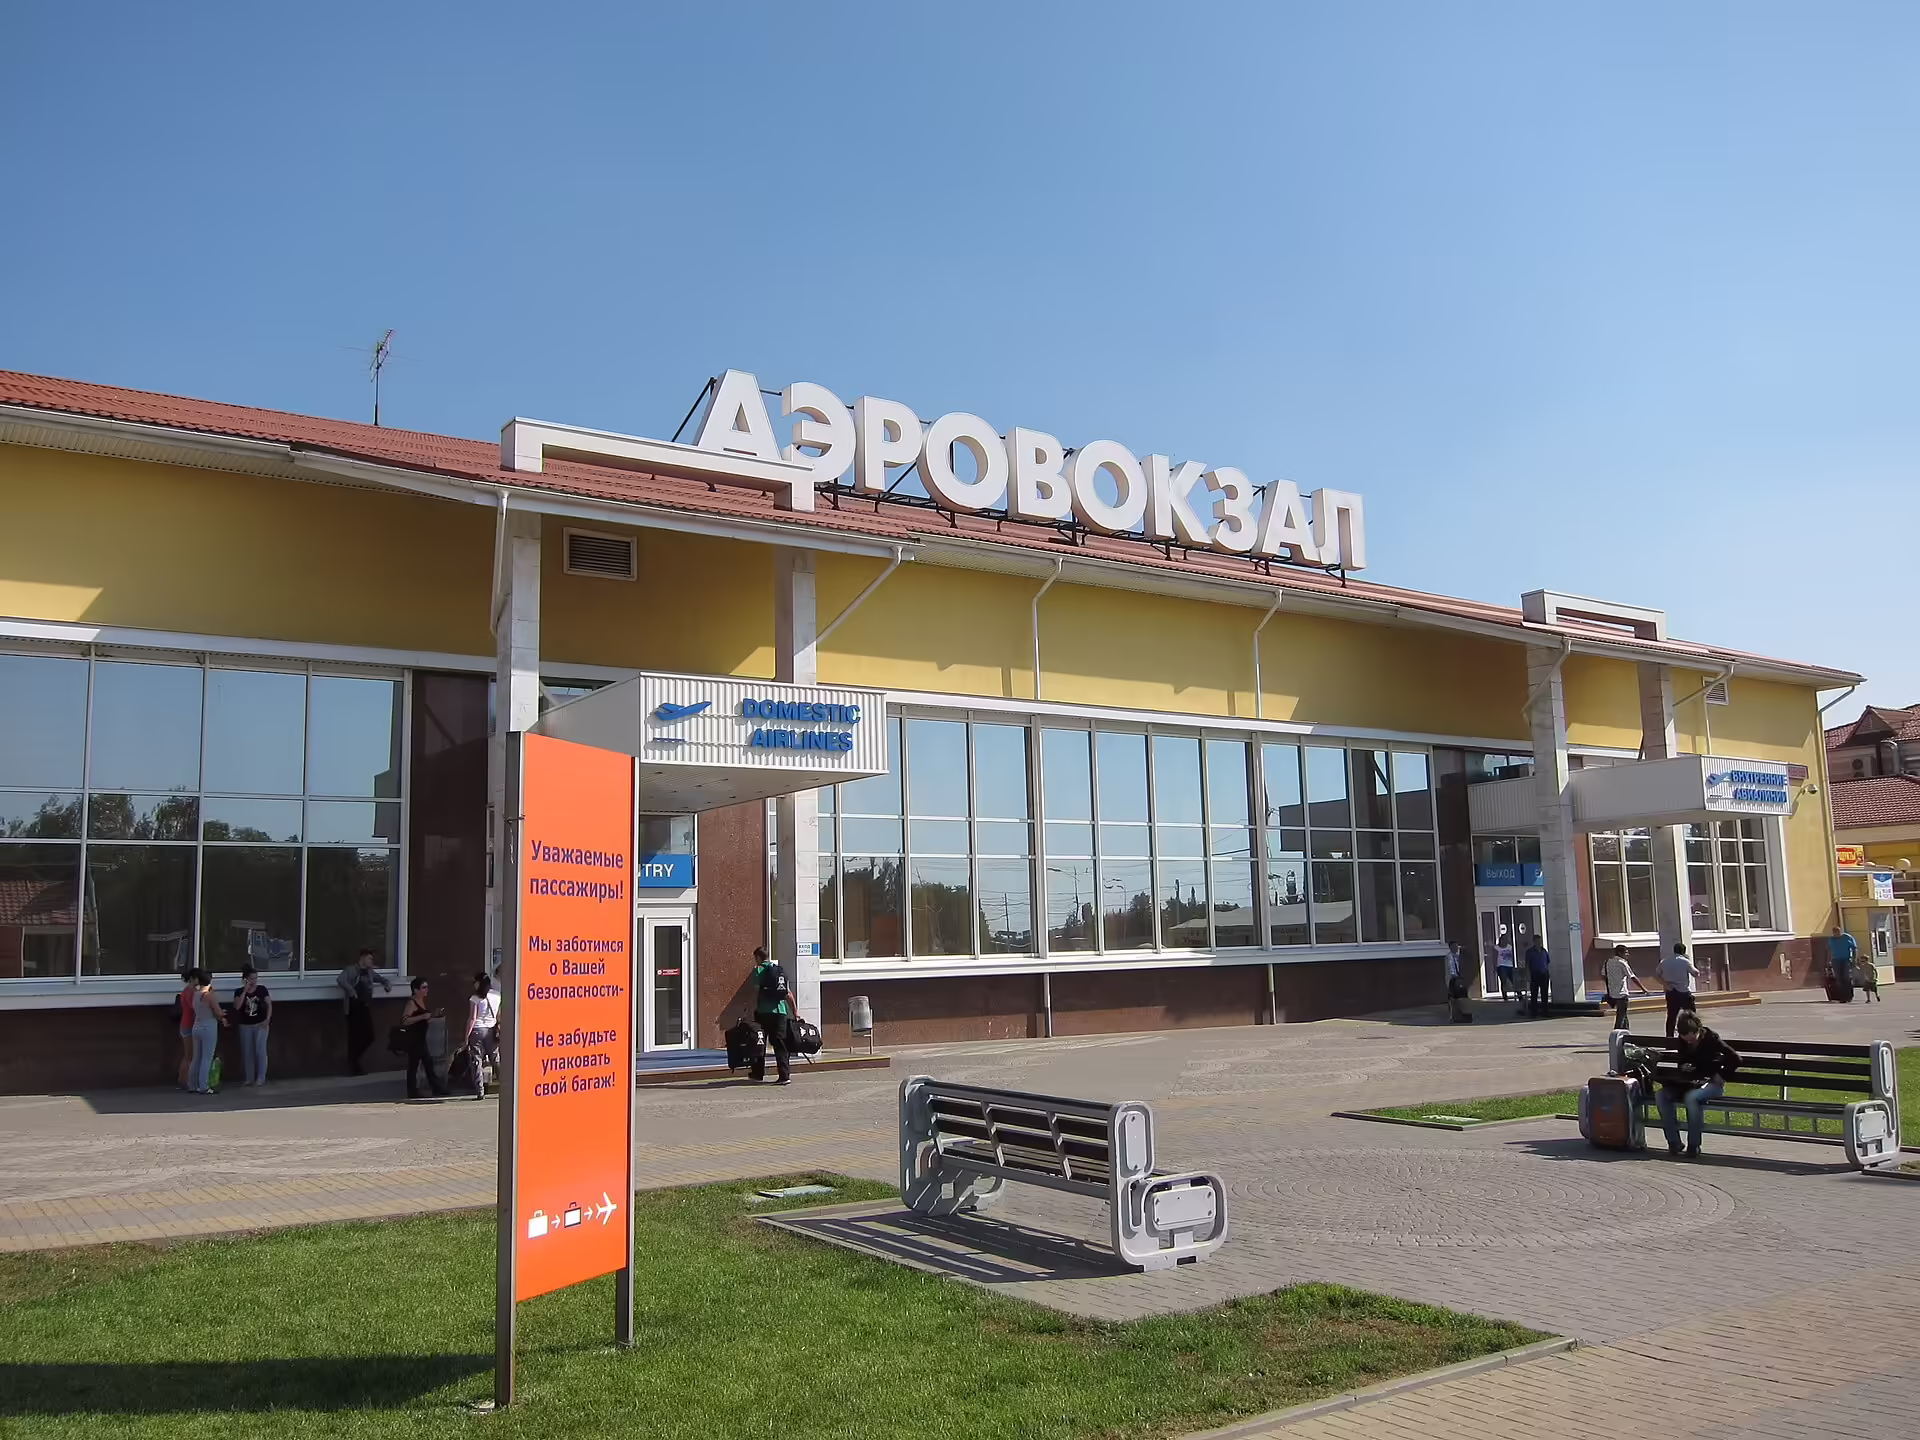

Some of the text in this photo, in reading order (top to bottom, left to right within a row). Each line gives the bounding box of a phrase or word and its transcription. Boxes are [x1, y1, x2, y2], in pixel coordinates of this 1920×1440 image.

[693, 368, 1366, 571] АЭРОВОКЗАЛ
[743, 698, 861, 725] DOMESTIC
[751, 728, 853, 752] AIRLINES
[1731, 770, 1788, 786] ВНУТРЕННИЕ
[1734, 788, 1788, 803] АВИАЛИНИИ
[531, 839, 624, 869] Уважаемые
[638, 863, 675, 878] TRY
[1486, 868, 1516, 879] ВЫХОД
[529, 878, 624, 904] пассажиры!
[528, 935, 624, 953] Мы заботимся
[549, 957, 605, 976] о Вашей
[535, 1027, 617, 1049] Не забудьте
[541, 1052, 611, 1077] упаковать
[534, 1071, 616, 1097] свой багаж!
